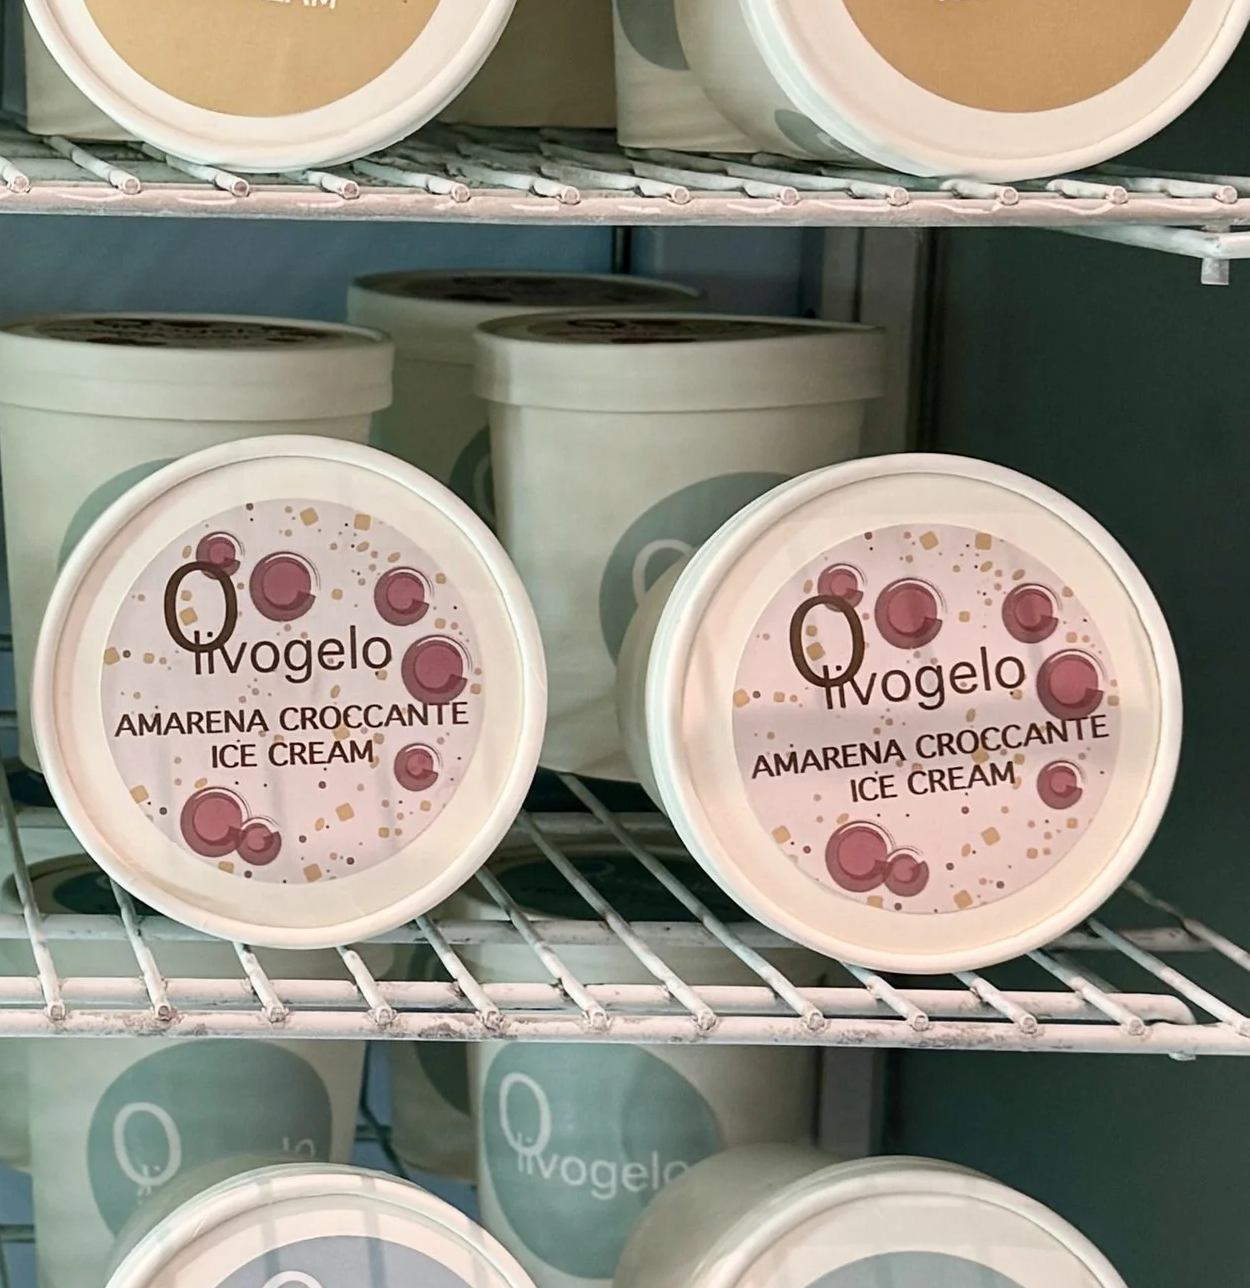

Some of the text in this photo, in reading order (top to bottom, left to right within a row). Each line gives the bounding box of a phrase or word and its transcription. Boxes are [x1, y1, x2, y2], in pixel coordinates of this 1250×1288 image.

[114, 701, 470, 739] AMARENA CROCCANTE
[211, 738, 375, 770] ICE CREAM
[751, 715, 1110, 781] AMARENA CROCCANTE
[850, 761, 1018, 803] ICE CREAM
